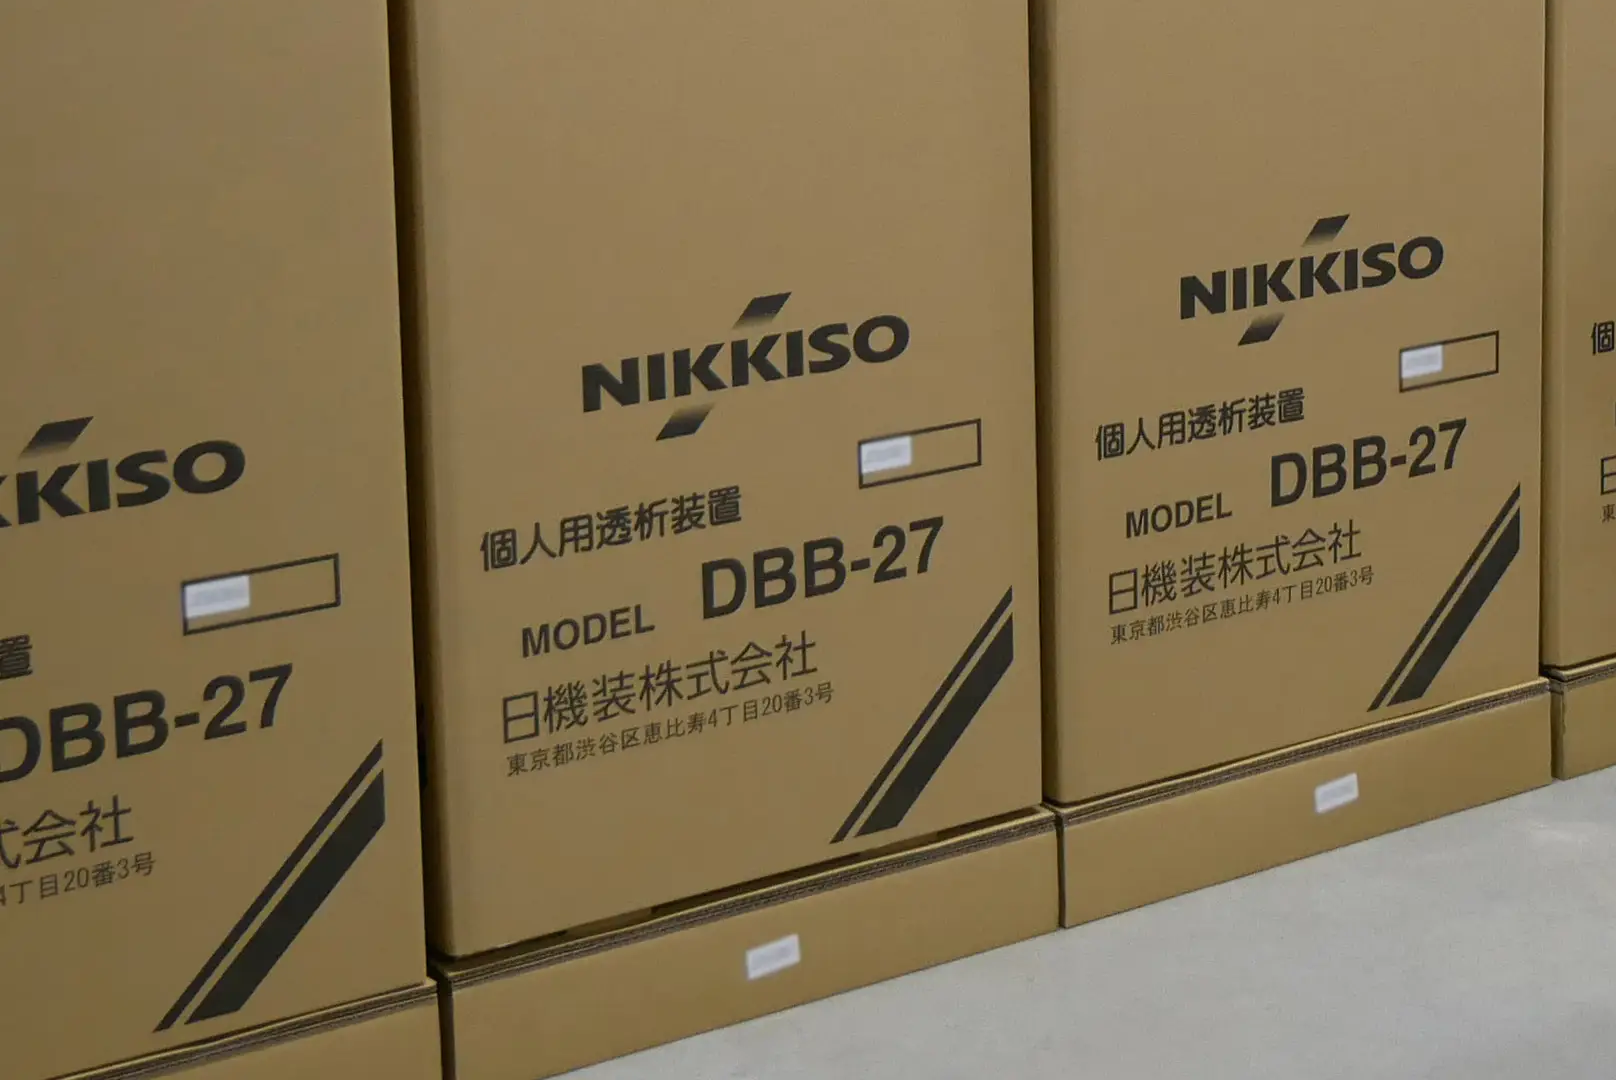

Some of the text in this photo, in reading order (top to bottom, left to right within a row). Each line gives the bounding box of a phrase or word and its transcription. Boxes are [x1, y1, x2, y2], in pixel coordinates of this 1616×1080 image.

[1180, 236, 1444, 320] NIKKISO
[581, 315, 910, 413] NIKKISO
[1095, 387, 1305, 461] 個人用透析装置
[0, 439, 246, 528] KISO
[1125, 417, 1467, 539] MODEL DBB-27
[480, 485, 741, 572] 個人用透析装置
[1108, 519, 1362, 615] 日機装株式会社
[521, 516, 945, 658] MODEL DBB-27
[1111, 565, 1374, 645] 東京都渋谷区恵比寿4丁目20番3号
[0, 663, 293, 784] DBB-27
[502, 630, 818, 744] 日機装株式会社
[506, 682, 834, 778] 東京都渋谷区恵比寿4丁目20番3号
